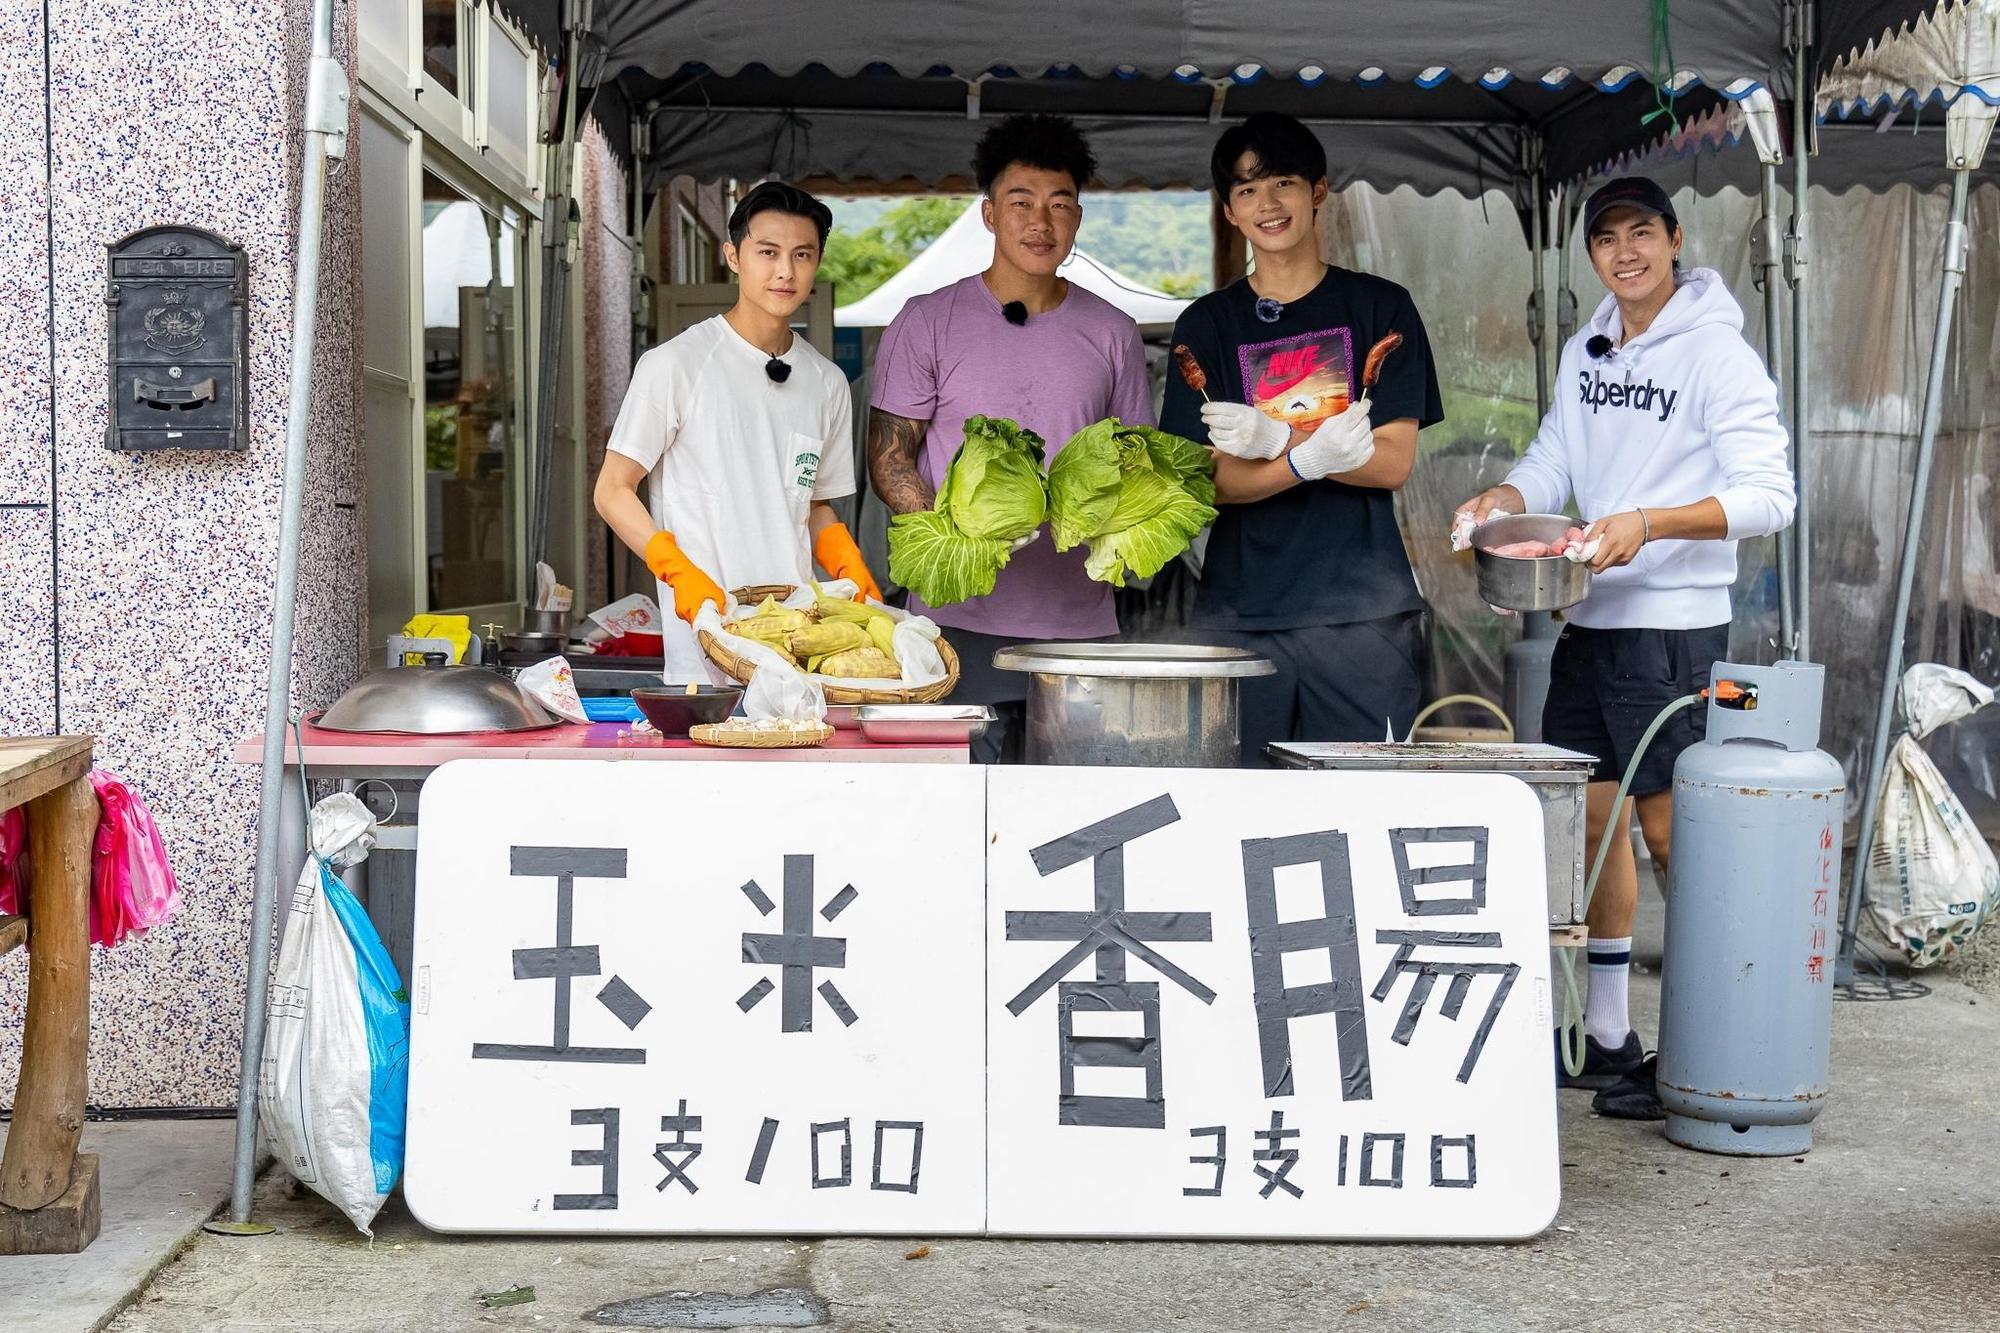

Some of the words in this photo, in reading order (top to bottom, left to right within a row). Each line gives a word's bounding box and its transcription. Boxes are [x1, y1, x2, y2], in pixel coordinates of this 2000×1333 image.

[1266, 344, 1320, 378] NIKE
[472, 846, 858, 1064] 玉米
[1005, 793, 1521, 1128] 香腸
